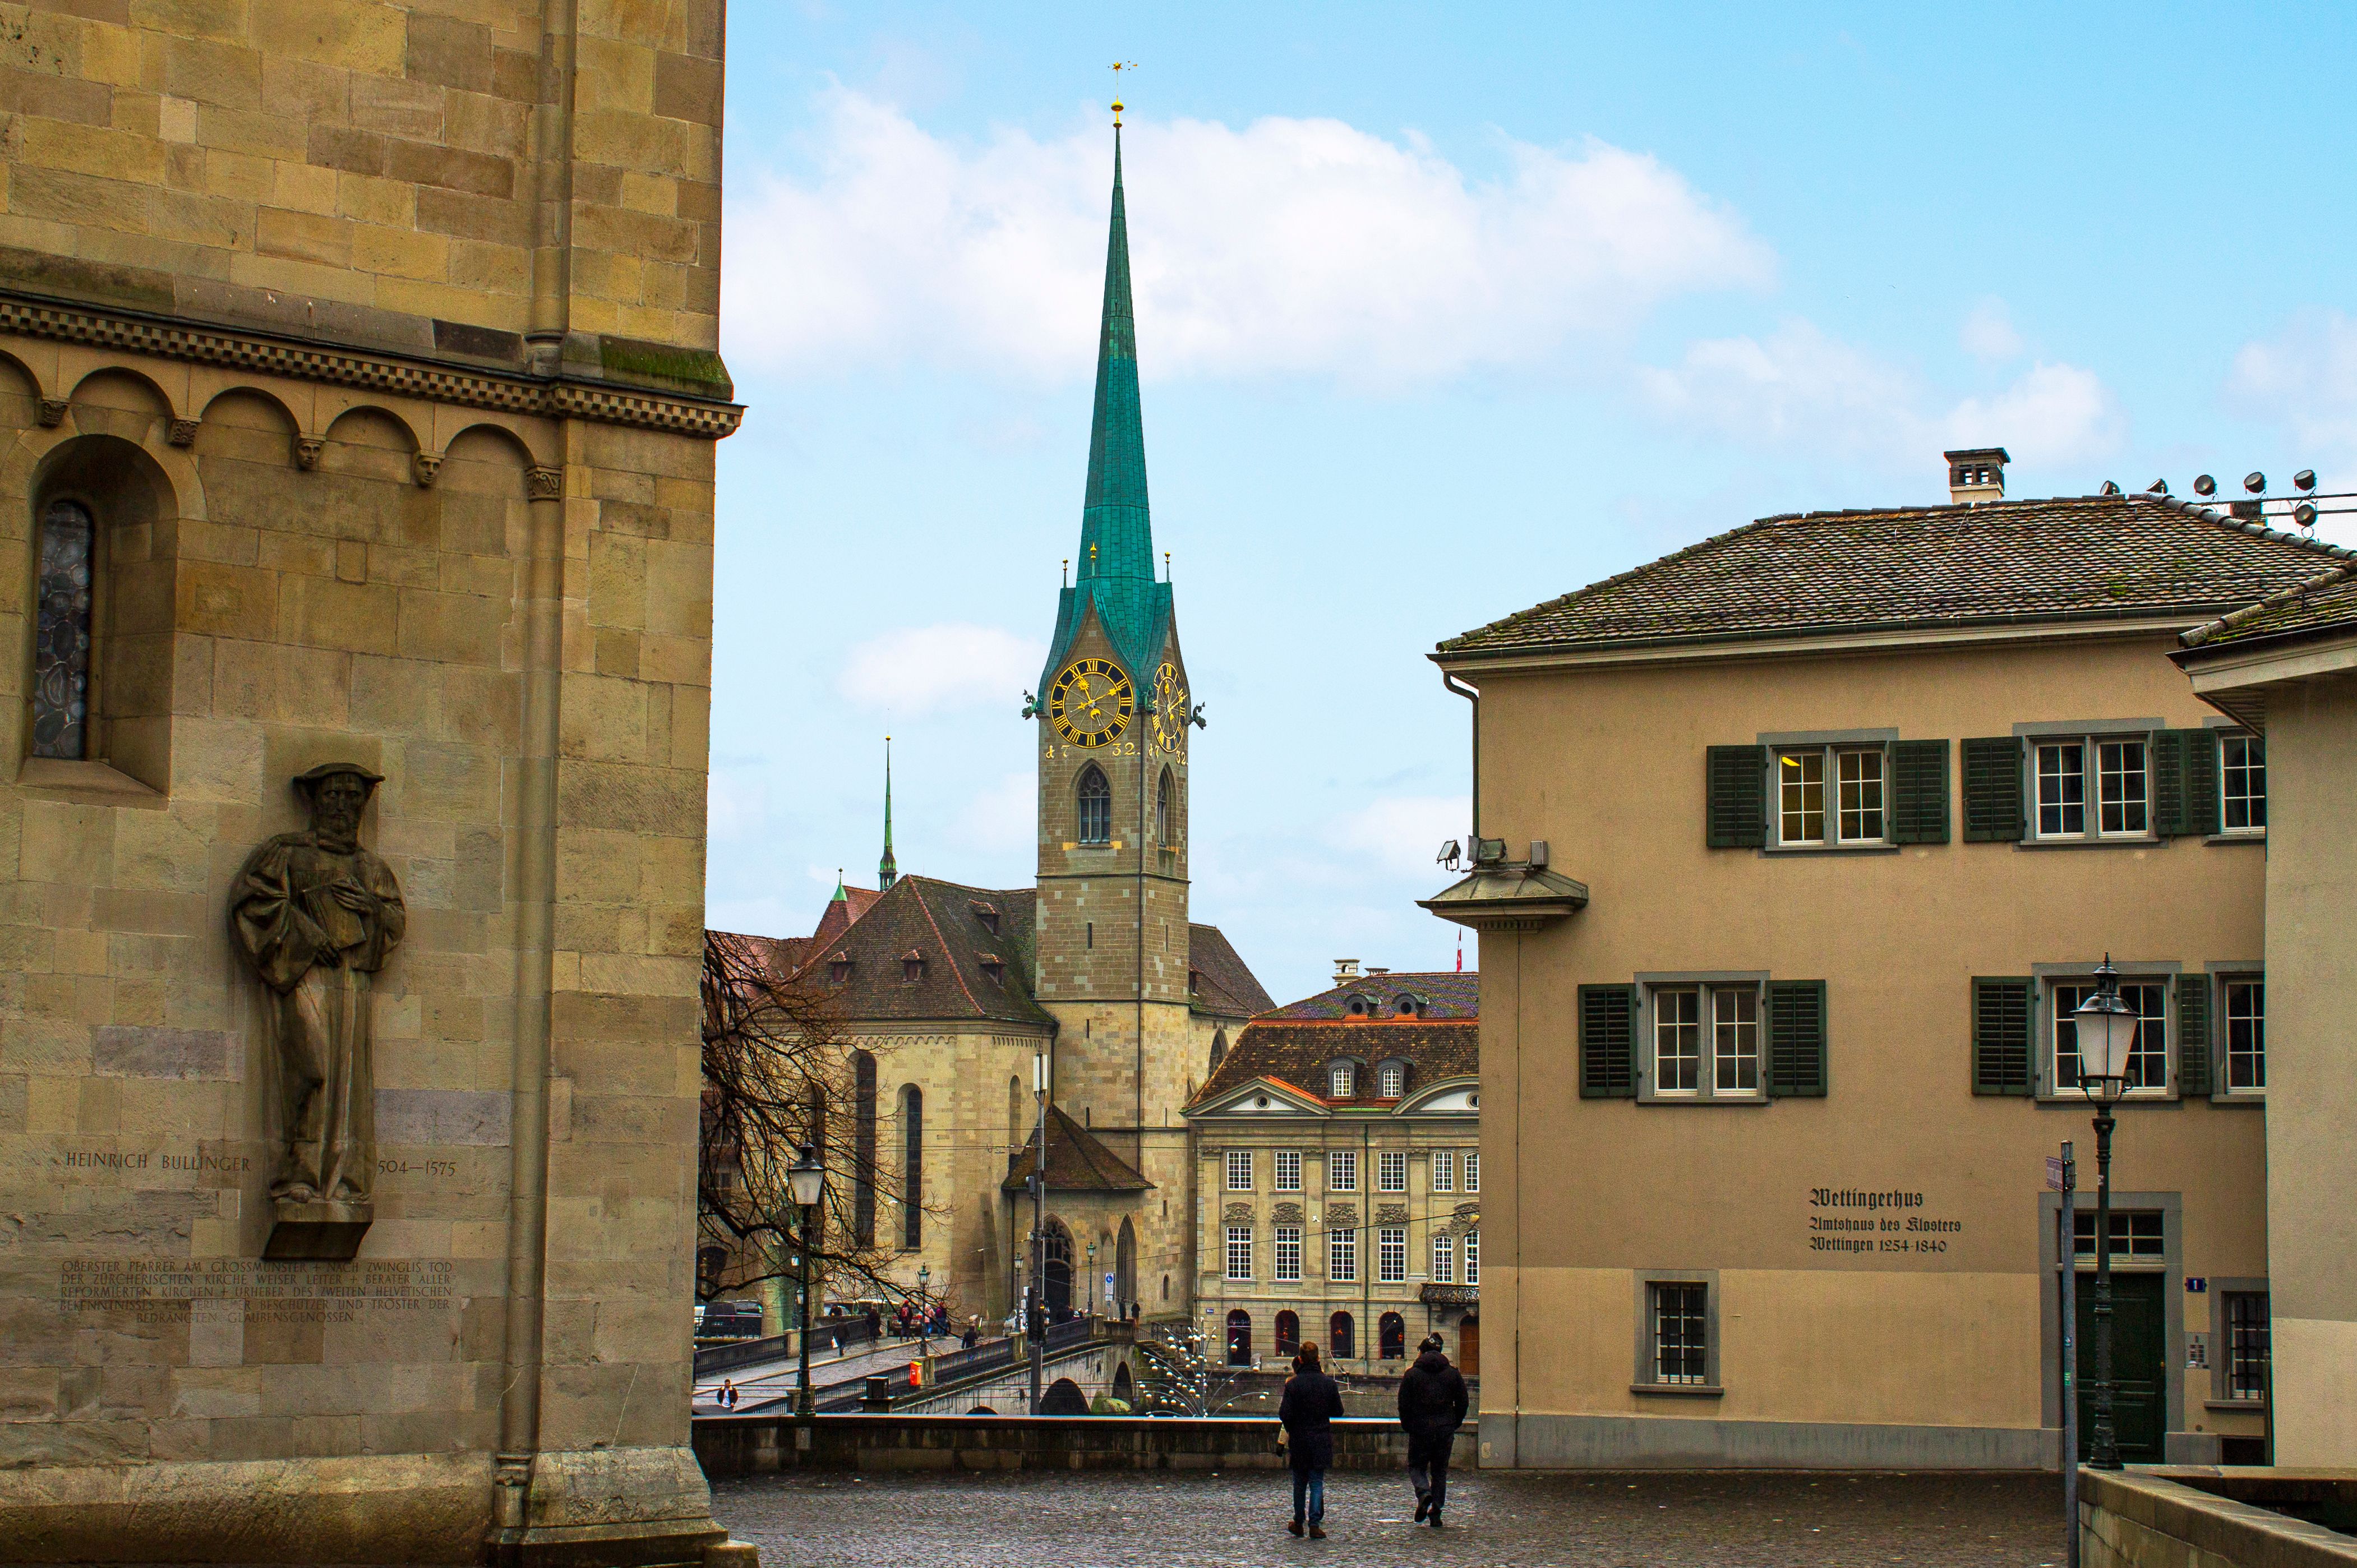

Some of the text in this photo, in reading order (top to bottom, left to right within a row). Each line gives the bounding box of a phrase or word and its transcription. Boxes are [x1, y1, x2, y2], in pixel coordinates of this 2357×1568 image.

[66, 1152, 250, 1172] HEINRICH BULLINGER
[379, 1160, 456, 1177] 504—1575
[1809, 1188, 1924, 1210] Wettingerhus
[1809, 1216, 1962, 1233] Amtshaus des Klosters
[1809, 1237, 1948, 1254] Wettingen 1254-1840
[62, 1261, 119, 1272] OBERSTER
[130, 1261, 175, 1272] PFARRER
[184, 1262, 201, 1272] AM
[327, 1262, 358, 1272] NACH
[367, 1262, 421, 1272] ZWINGLIS
[428, 1262, 452, 1272] TOD
[62, 1274, 85, 1285] DER
[205, 1274, 247, 1284] KIRCHE
[256, 1274, 298, 1285] WEISER
[307, 1274, 342, 1285] LEITER
[366, 1274, 410, 1284] BERATER
[419, 1275, 451, 1284] ALLER
[2193, 1280, 2198, 1290] 1
[61, 1286, 151, 1298] REFORMIERTEN
[162, 1286, 213, 1297] KIRCHEN
[236, 1286, 284, 1297] URHEBER
[293, 1286, 313, 1297] DES
[321, 1286, 366, 1297] ZWEITEN
[376, 1286, 452, 1297] HELVETISCHEN
[338, 1299, 363, 1310] UND
[429, 1299, 450, 1310] DER
